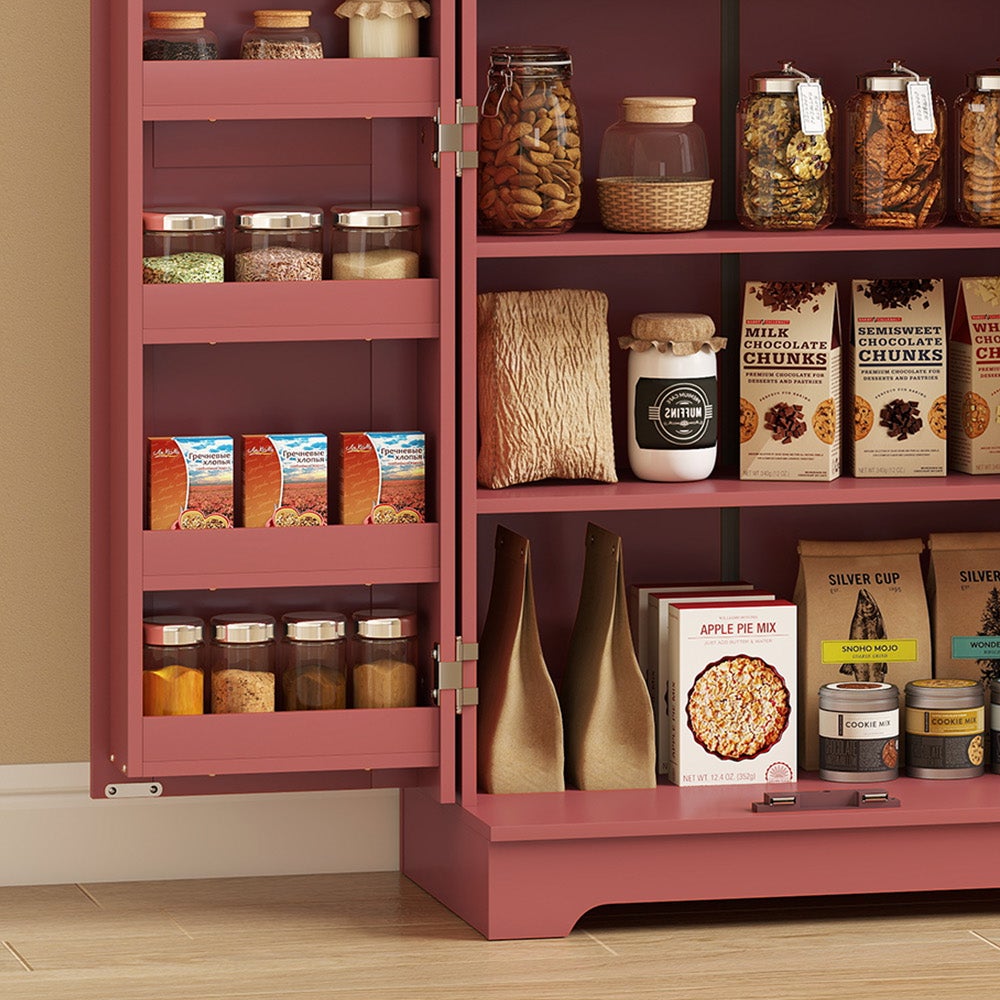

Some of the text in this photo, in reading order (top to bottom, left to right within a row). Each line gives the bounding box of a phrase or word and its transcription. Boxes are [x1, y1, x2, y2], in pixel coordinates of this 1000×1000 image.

[744, 328, 790, 338] MILK
[858, 326, 942, 336] SEMISWEET
[744, 340, 828, 350] CHOCOLATE
[859, 338, 943, 347] CHOCOLATE
[743, 352, 827, 365] CHUNKS
[859, 349, 943, 362] CHUNKS
[188, 452, 231, 461] Гречневые
[282, 450, 325, 459] Гречневые
[380, 448, 423, 456] Гречневые
[828, 572, 901, 586] SILVER CUP
[700, 622, 777, 636] APPLE PIE MIX
[842, 644, 898, 653] SNOHO MOJO
[845, 720, 877, 729] COOKIE
[931, 718, 963, 726] COOKIE
